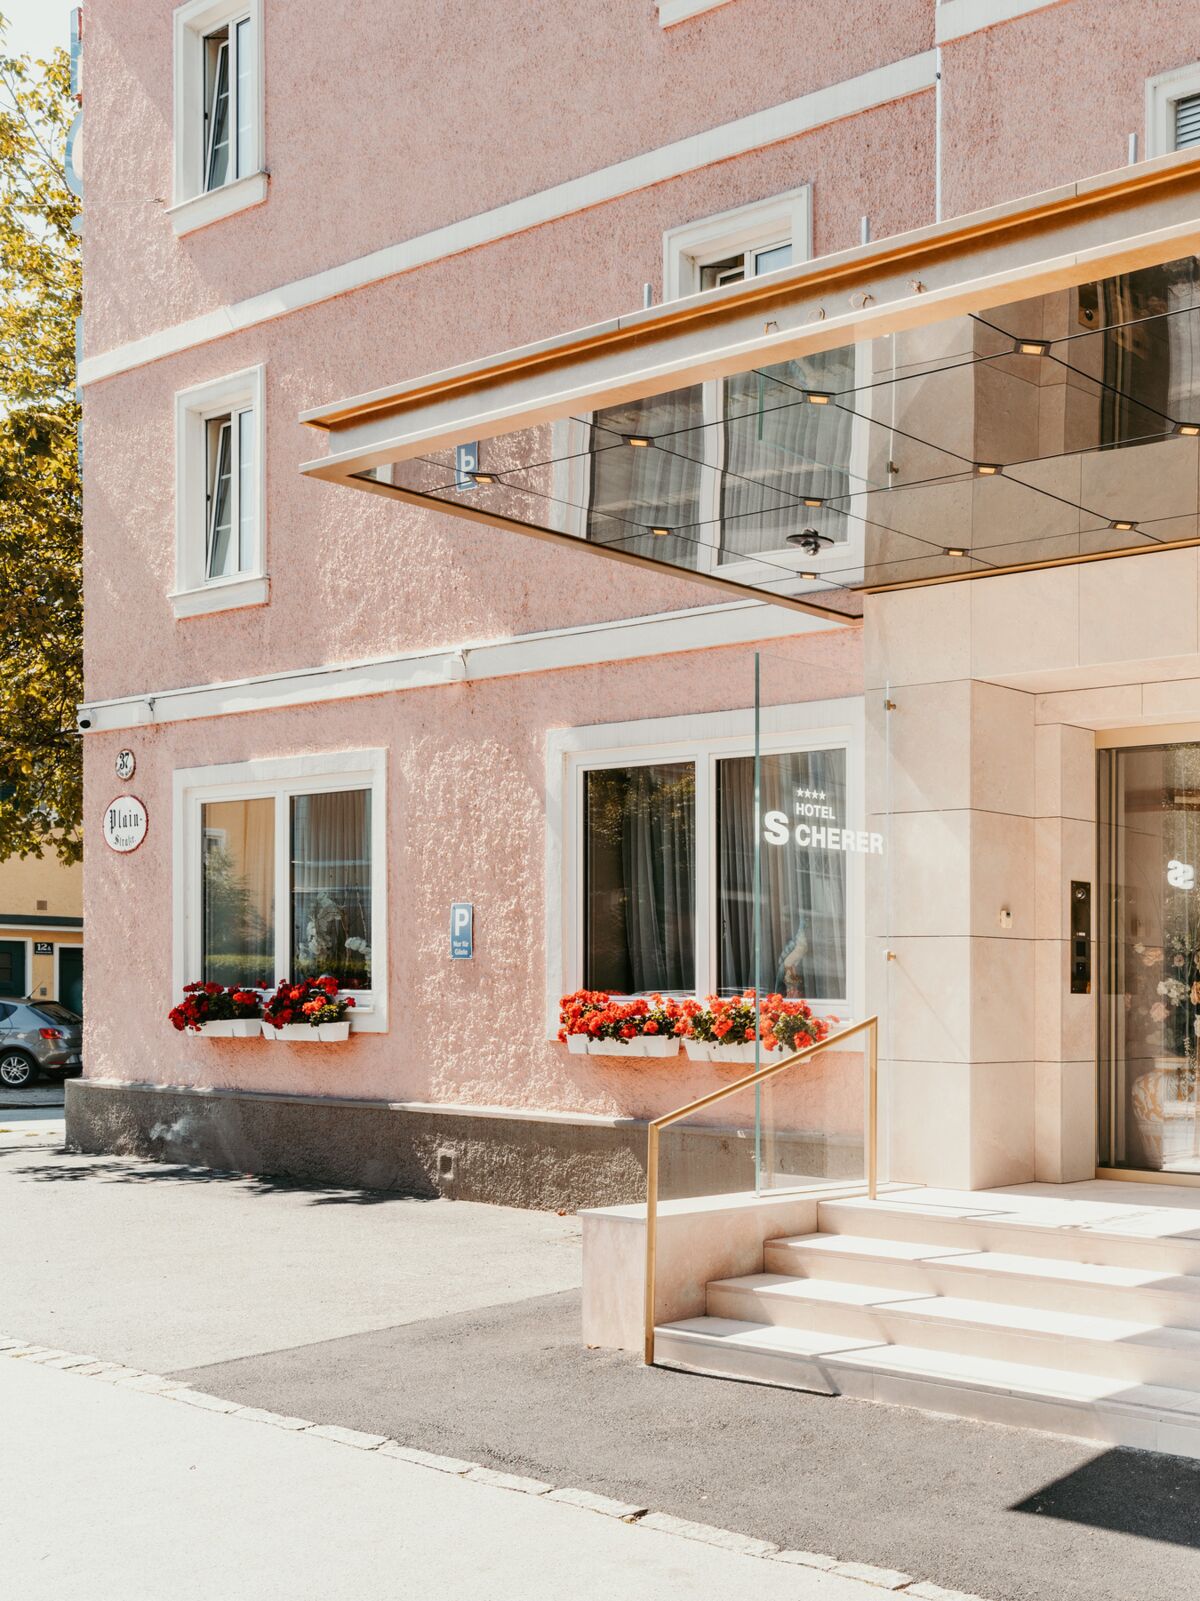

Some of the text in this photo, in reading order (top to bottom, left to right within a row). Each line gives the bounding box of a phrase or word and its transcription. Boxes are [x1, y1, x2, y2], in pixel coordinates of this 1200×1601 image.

[119, 752, 130, 770] 37
[109, 808, 143, 834] Plain-
[795, 802, 836, 820] HOTEL
[454, 908, 469, 937] P
